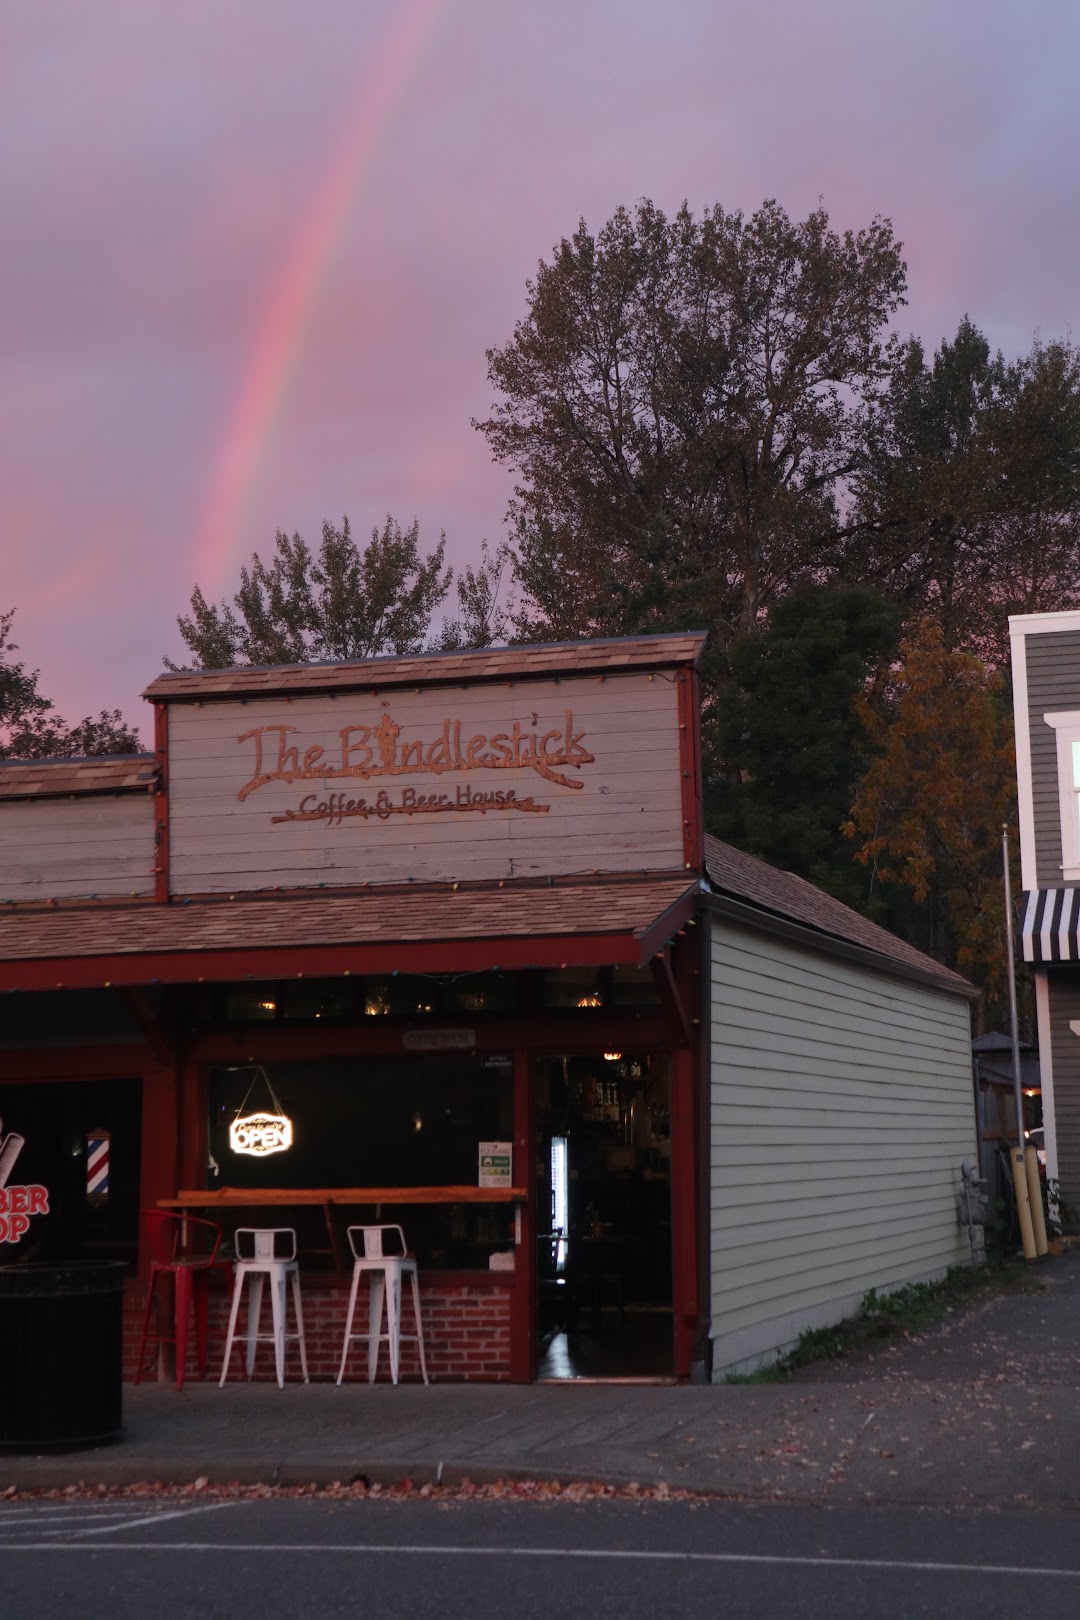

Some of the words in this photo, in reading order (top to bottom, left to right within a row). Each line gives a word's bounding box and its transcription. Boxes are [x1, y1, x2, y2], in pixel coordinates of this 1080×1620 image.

[238, 725, 327, 784] The
[300, 793, 367, 826] Coffee
[376, 790, 393, 820] &
[401, 787, 447, 808] Beer
[457, 784, 516, 807] House
[235, 1129, 286, 1148] OPEN
